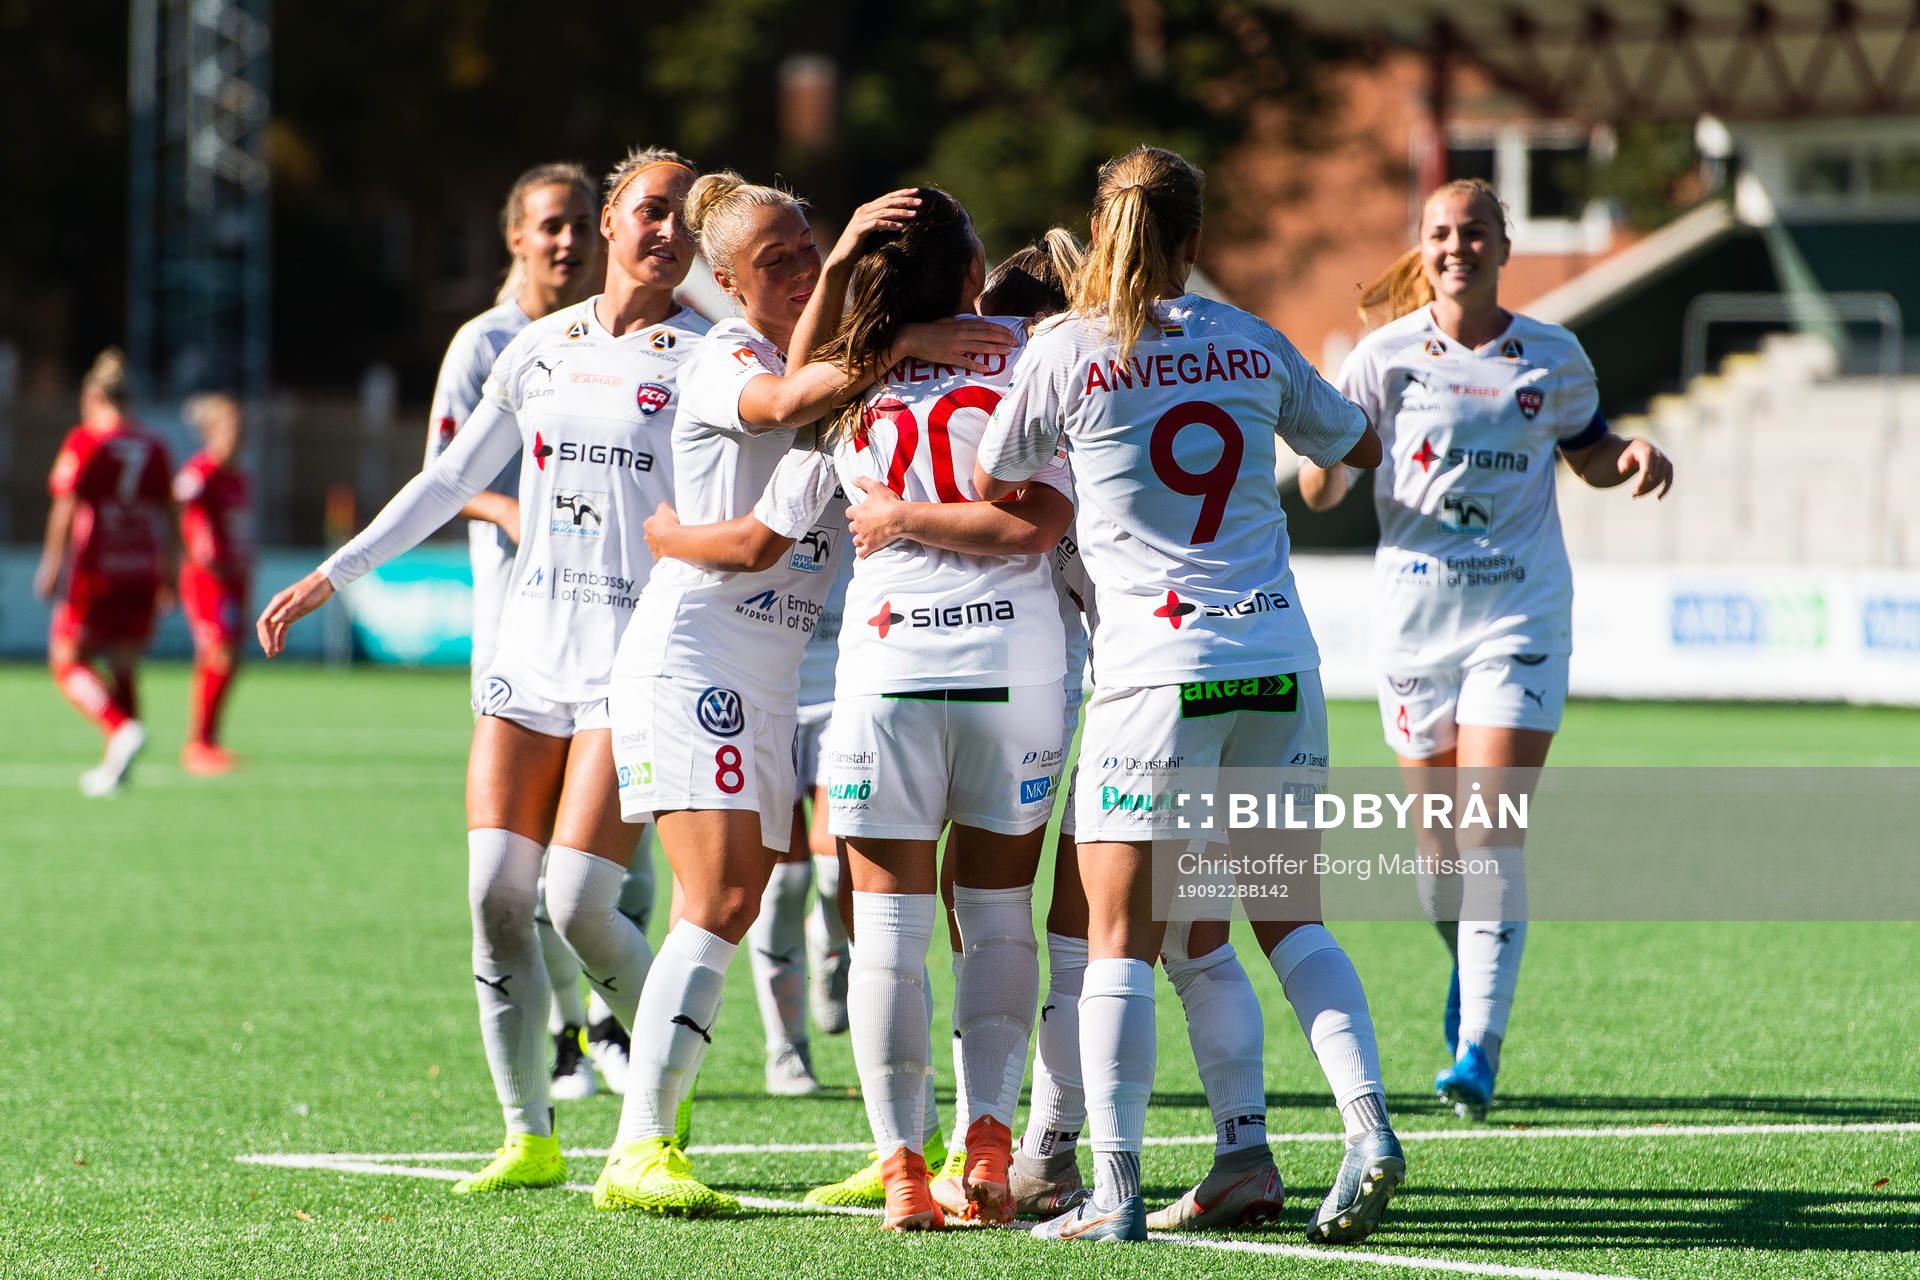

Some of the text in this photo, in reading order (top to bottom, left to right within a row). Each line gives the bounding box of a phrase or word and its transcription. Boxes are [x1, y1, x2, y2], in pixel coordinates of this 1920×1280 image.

[1085, 342, 1272, 396] ANVEGÅRD
[639, 388, 668, 403] FCR
[111, 440, 147, 502] 7
[1149, 400, 1245, 545] 9
[793, 553, 813, 562] OTTO
[1446, 553, 1516, 573] Embassy
[562, 567, 635, 594] Embassy
[1467, 565, 1526, 588] Sharing
[561, 587, 578, 601] of
[735, 605, 775, 624] MIDROC
[786, 614, 801, 632] of
[714, 744, 745, 795] 8
[1125, 756, 1181, 770] Damstahl
